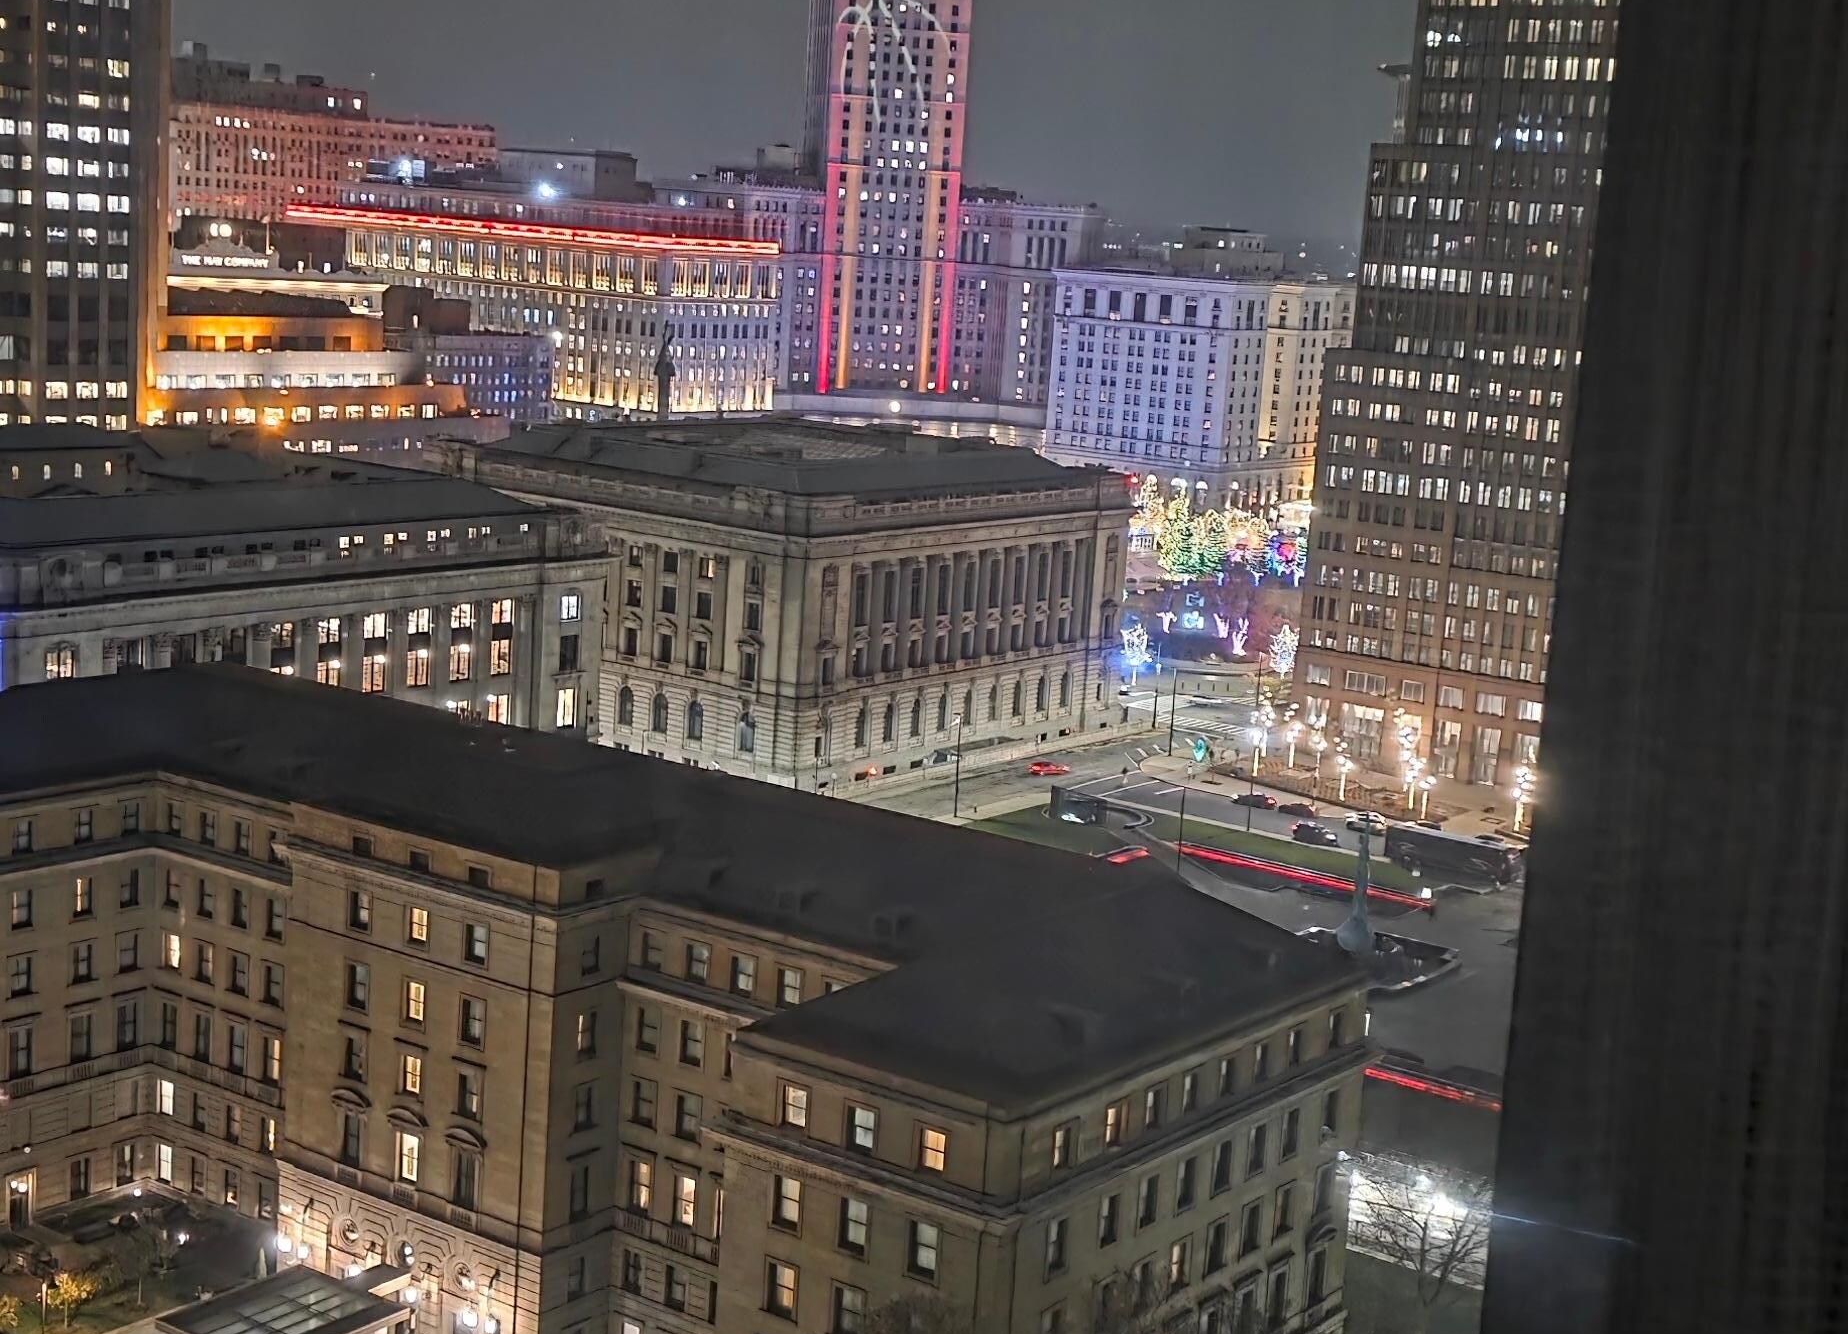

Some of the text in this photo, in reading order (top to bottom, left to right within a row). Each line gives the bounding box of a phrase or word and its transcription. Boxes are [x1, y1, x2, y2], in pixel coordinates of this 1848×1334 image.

[182, 254, 269, 268] THE MAY COMPANY
